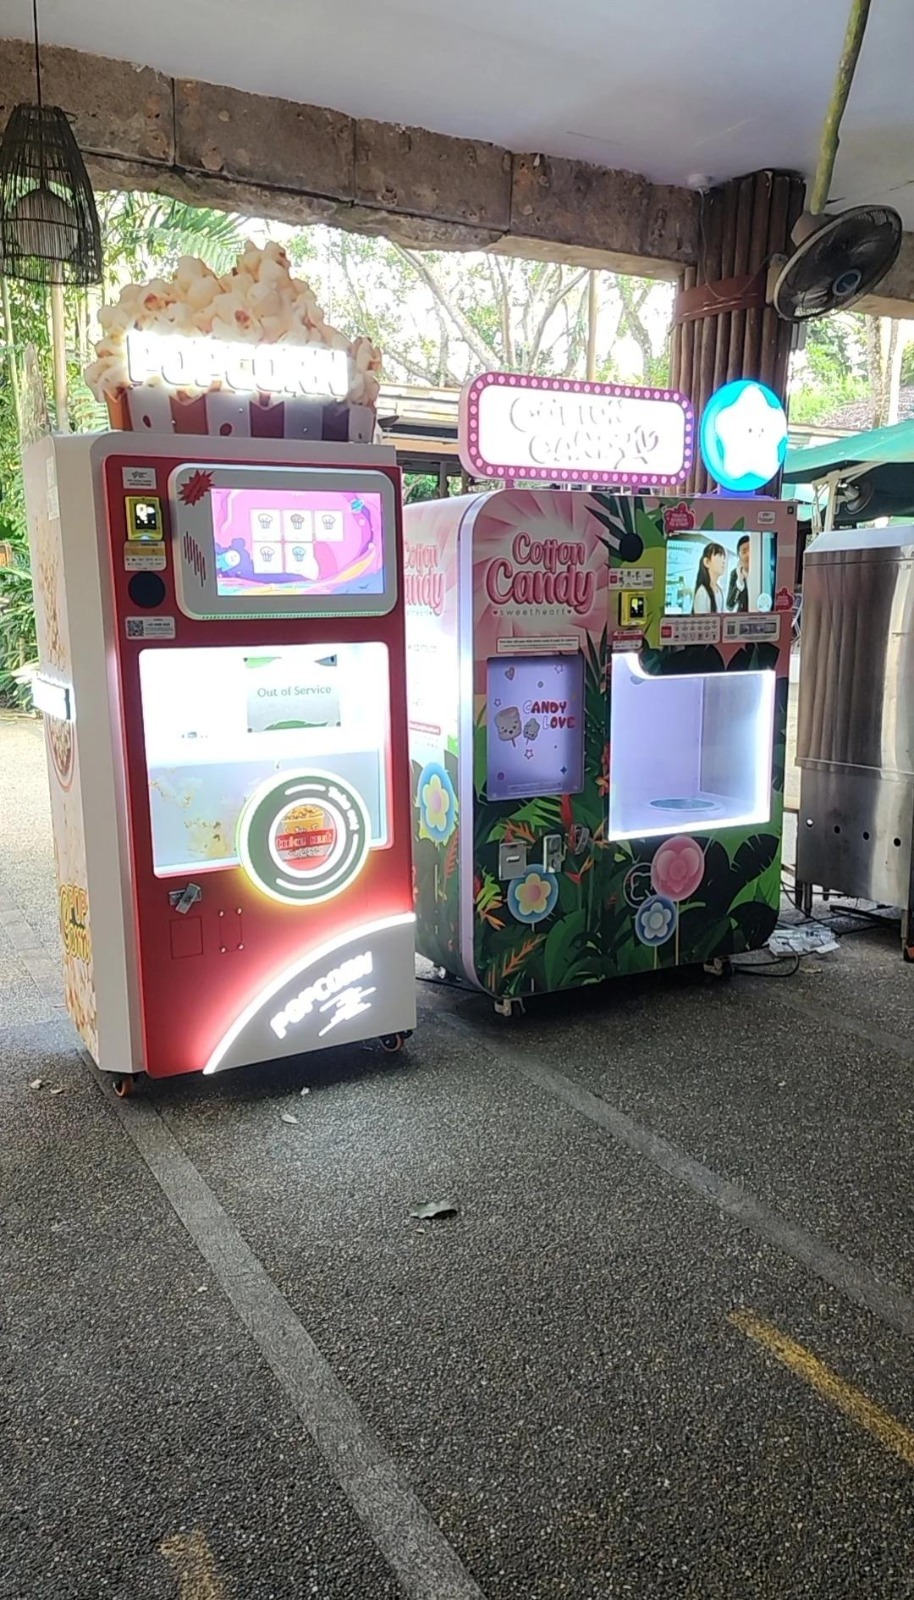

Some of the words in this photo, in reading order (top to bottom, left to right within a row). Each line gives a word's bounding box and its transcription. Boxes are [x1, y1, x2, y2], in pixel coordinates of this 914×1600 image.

[126, 331, 348, 397] POPCORN
[512, 532, 586, 574] Cotton
[486, 557, 596, 615] Candy
[500, 608, 568, 616] sweetheart
[257, 687, 278, 698] Out
[281, 686, 291, 696] of
[294, 685, 332, 696] Service
[523, 700, 568, 714] CANDY
[542, 715, 576, 729] LOVE
[270, 951, 373, 1039] POPCORN
